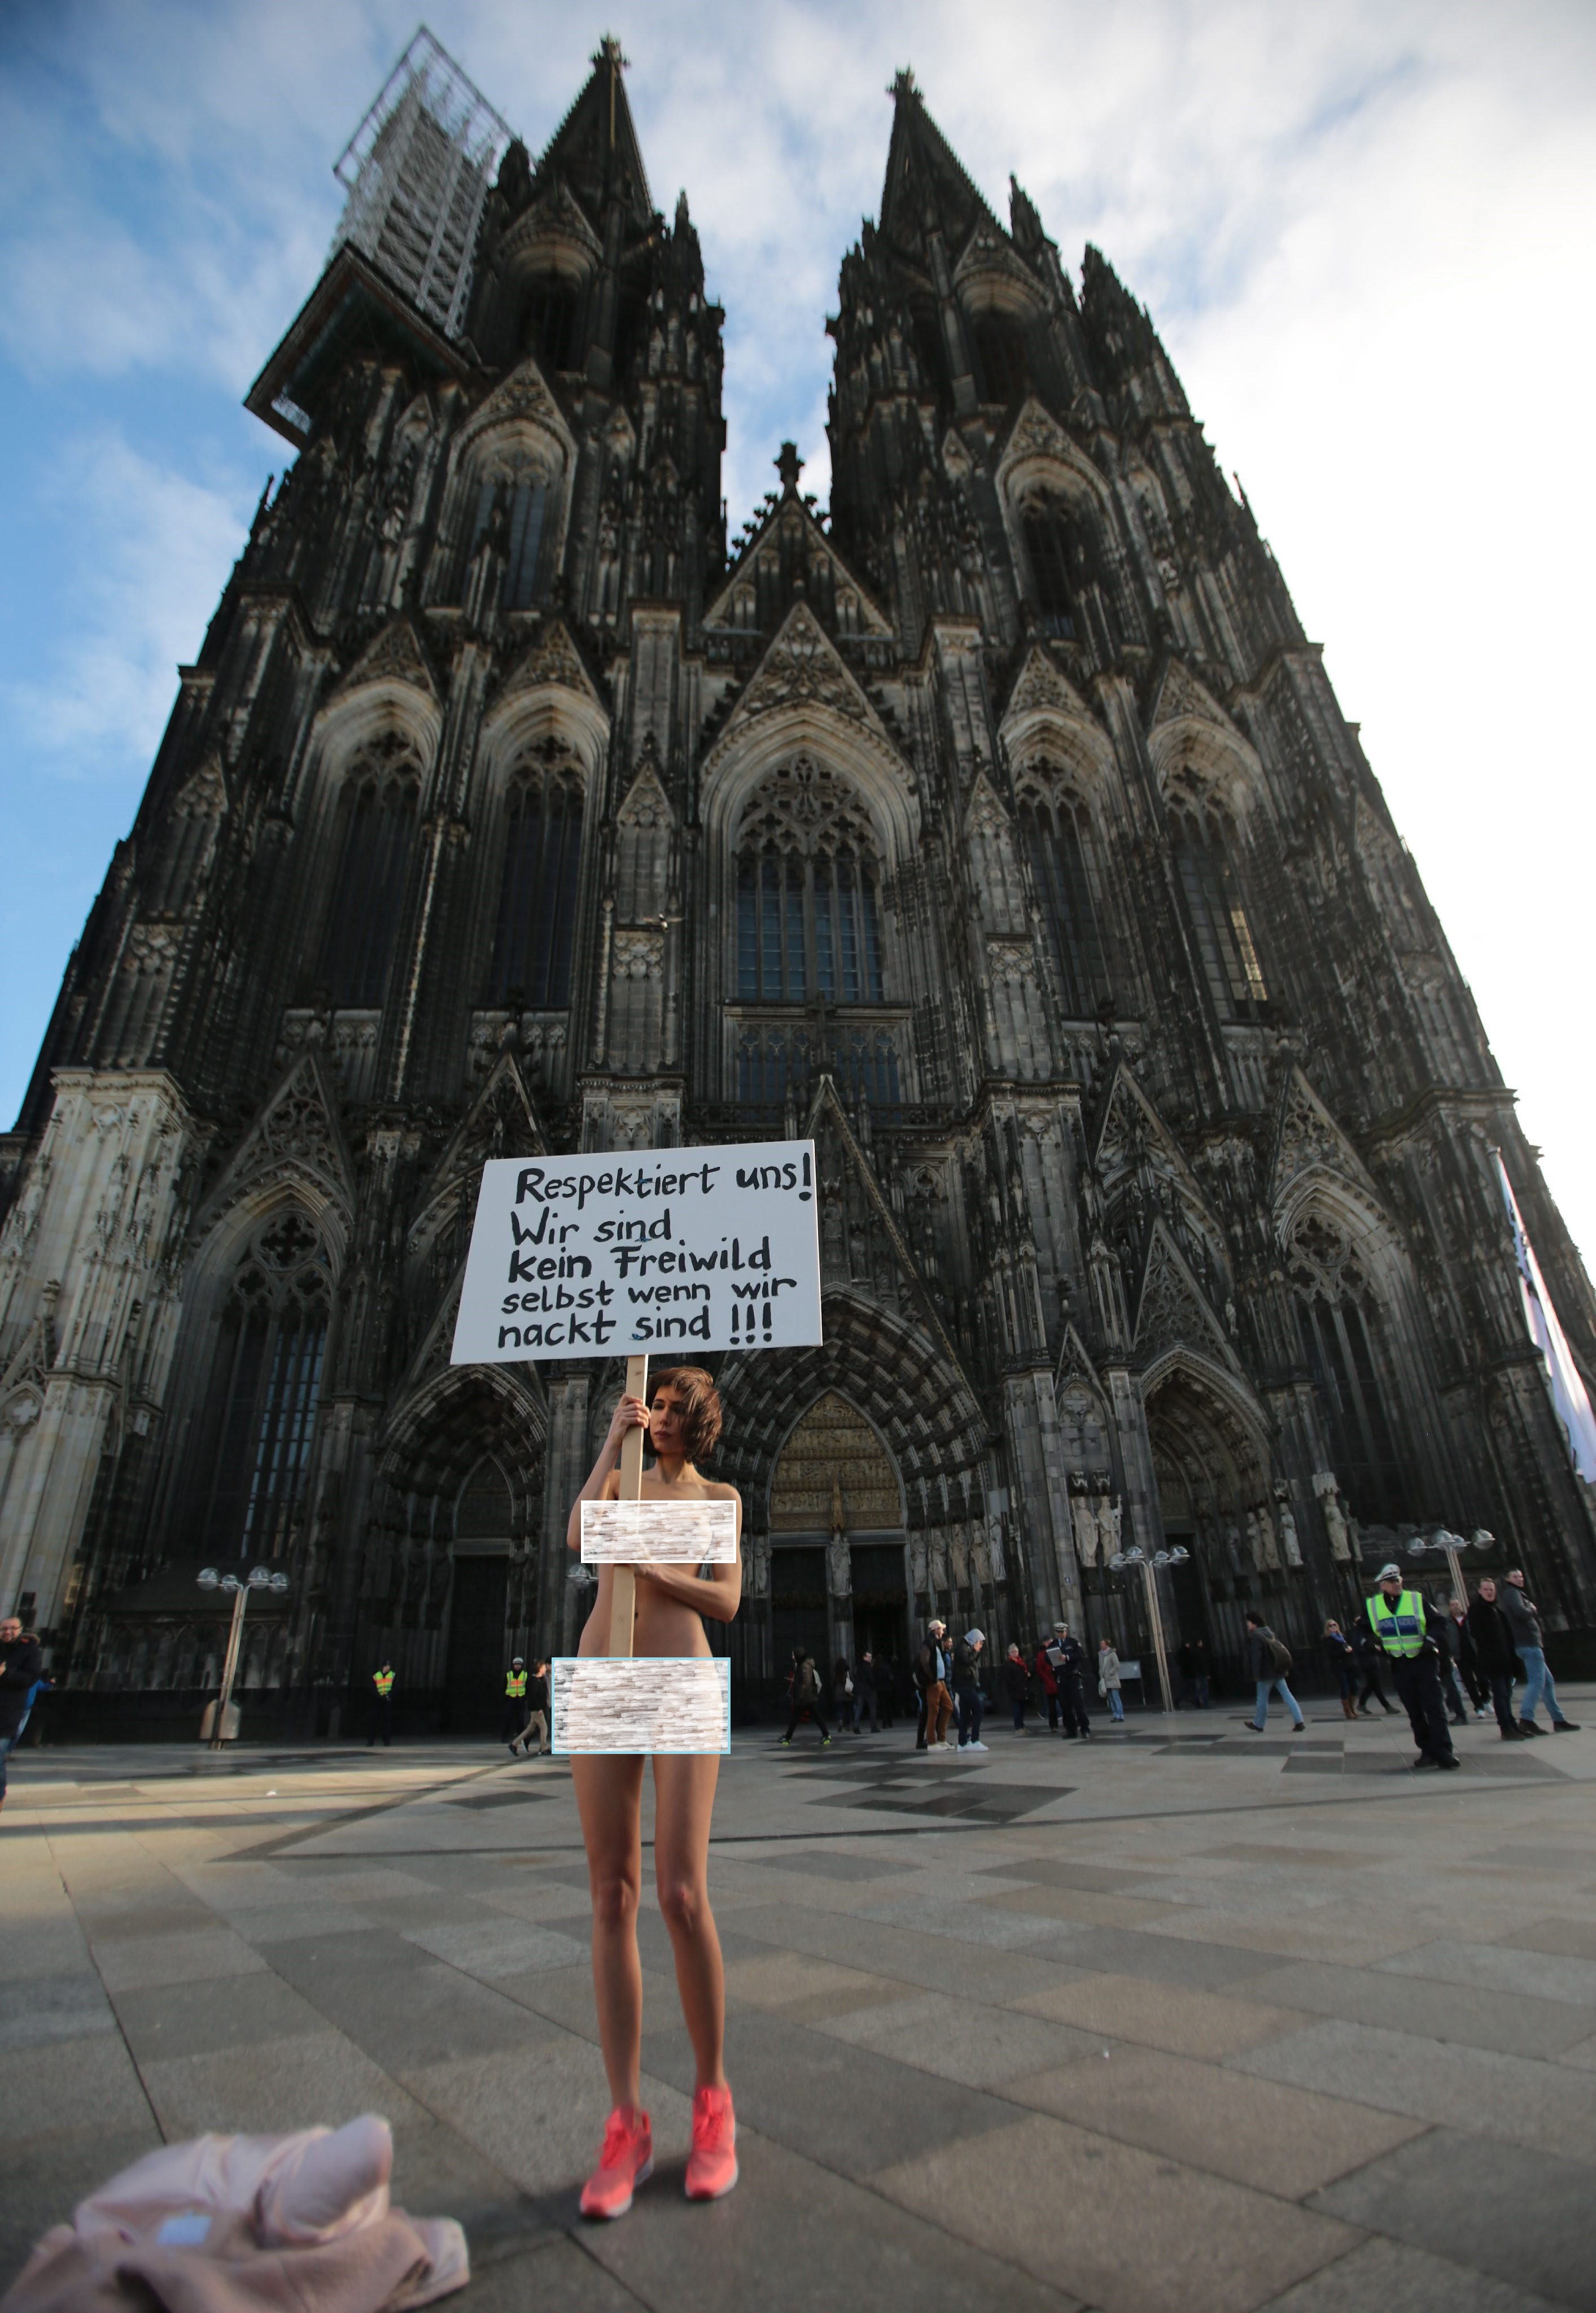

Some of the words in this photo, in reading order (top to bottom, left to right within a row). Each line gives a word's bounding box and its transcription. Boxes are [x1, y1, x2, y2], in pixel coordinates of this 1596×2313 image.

[515, 1163, 721, 1210] Respektiert
[736, 1152, 812, 1202] uns!
[510, 1206, 580, 1246] Wir
[593, 1208, 672, 1243] sind
[508, 1246, 593, 1284] kein
[610, 1236, 772, 1279] Freiwild
[501, 1280, 615, 1315] selbst
[628, 1283, 711, 1304] wenn
[731, 1272, 797, 1300] wir
[497, 1309, 617, 1349] nackt
[633, 1305, 711, 1341] sind
